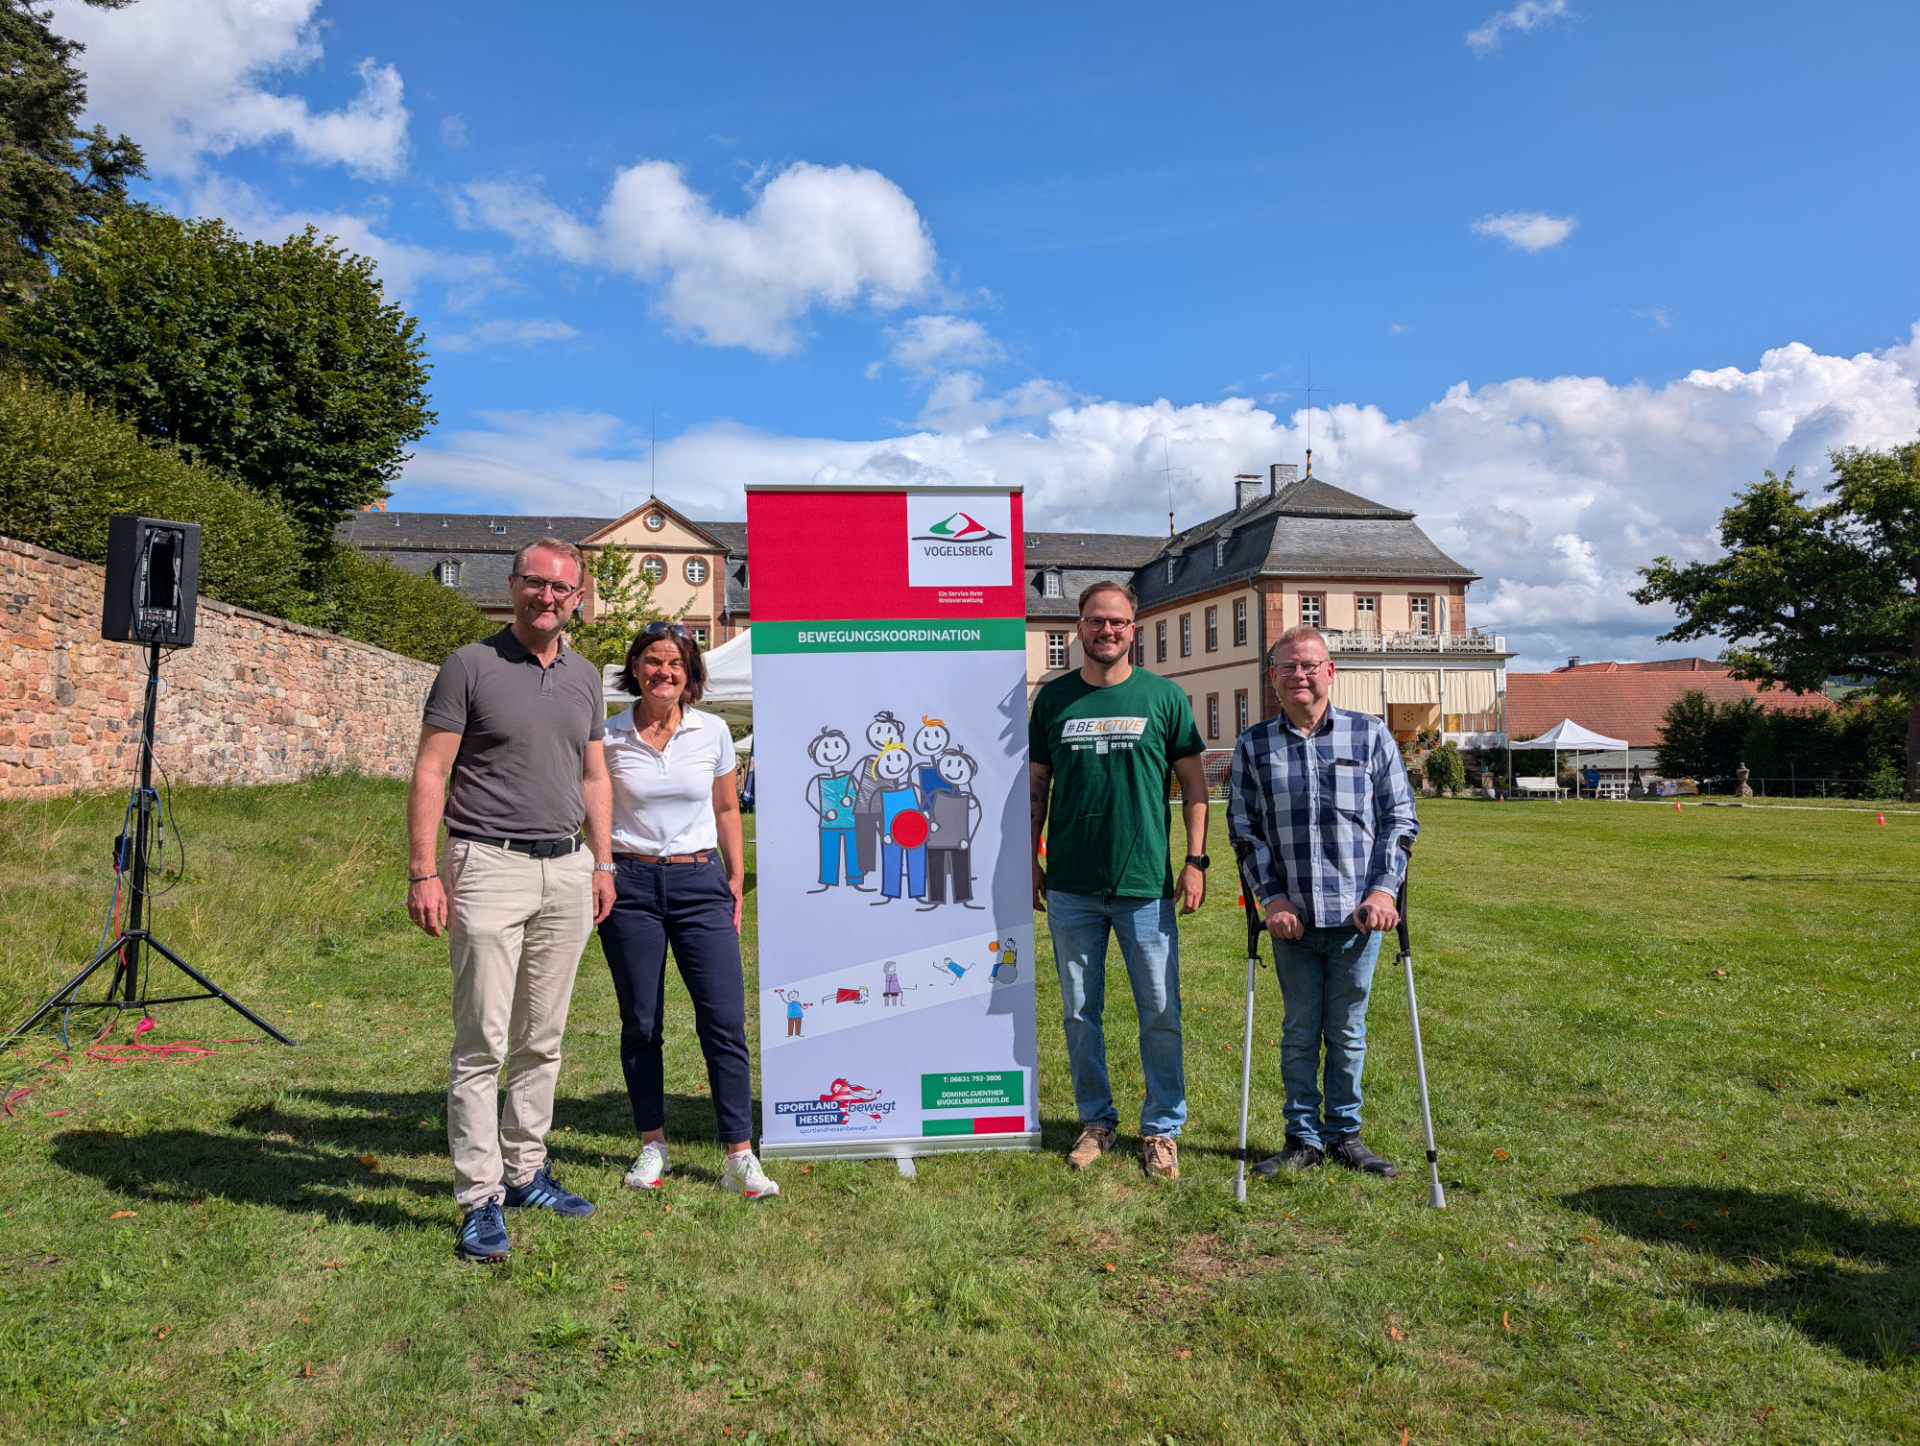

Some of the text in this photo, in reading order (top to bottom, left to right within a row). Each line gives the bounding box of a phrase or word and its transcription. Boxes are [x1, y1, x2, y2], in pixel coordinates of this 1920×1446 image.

[924, 546, 993, 556] VOGELSBERG
[798, 629, 981, 643] BEWEGUNGSKOORDINATION
[1066, 719, 1144, 733] #BEACTIVE
[971, 1074, 1002, 1082] 792-3806
[936, 1096, 1010, 1106] @VOGELSBERGKREIS.DE
[777, 1101, 838, 1113] SPORTLAND
[848, 1100, 896, 1114] bewegt
[799, 1114, 838, 1124] HESSEN
